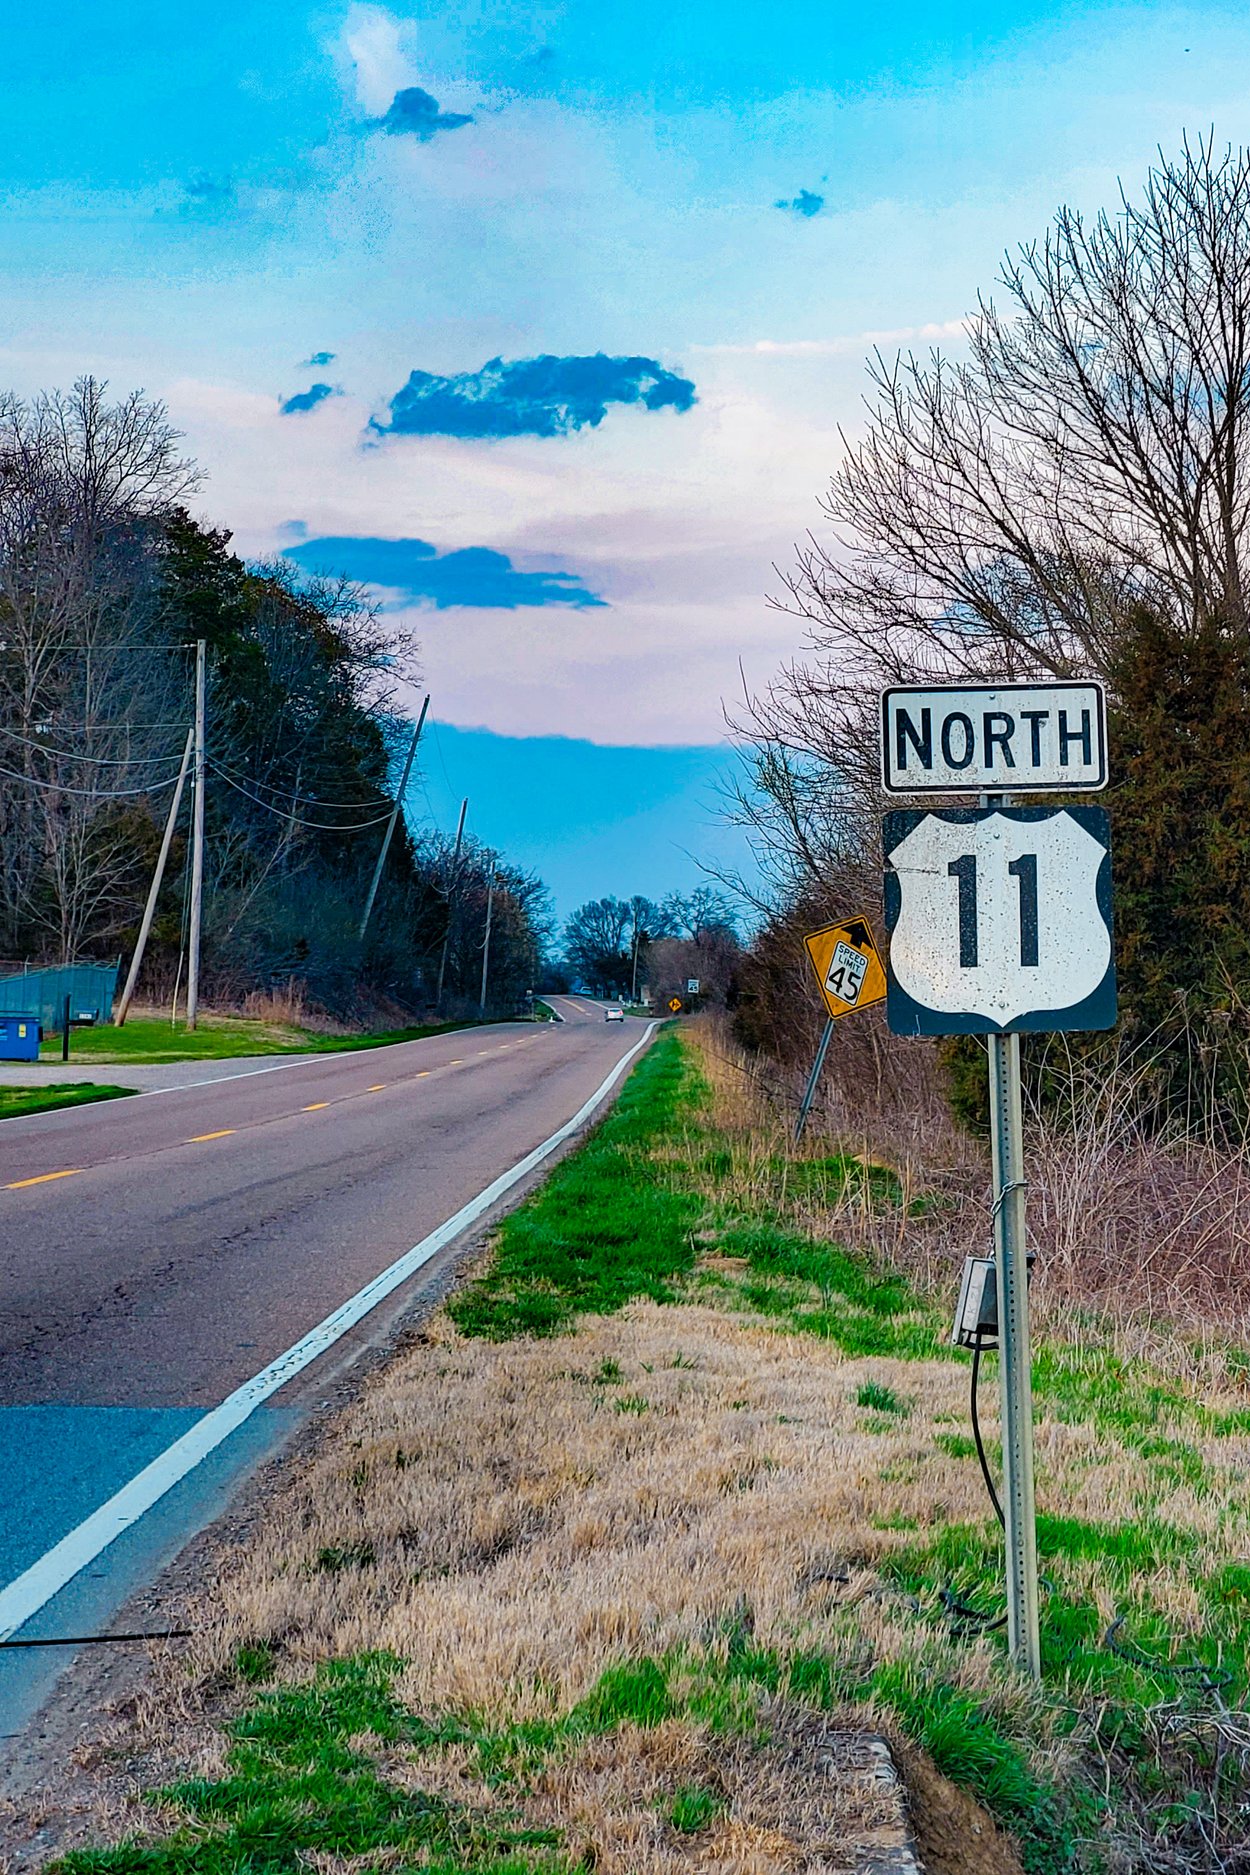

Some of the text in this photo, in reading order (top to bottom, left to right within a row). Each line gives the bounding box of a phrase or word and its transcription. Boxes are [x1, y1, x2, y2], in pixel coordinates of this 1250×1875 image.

[895, 708, 1092, 770] NORTH
[947, 853, 1039, 968] 11
[838, 945, 865, 966] SPEED
[838, 955, 860, 972] LIMIT
[829, 966, 861, 1000] 45
